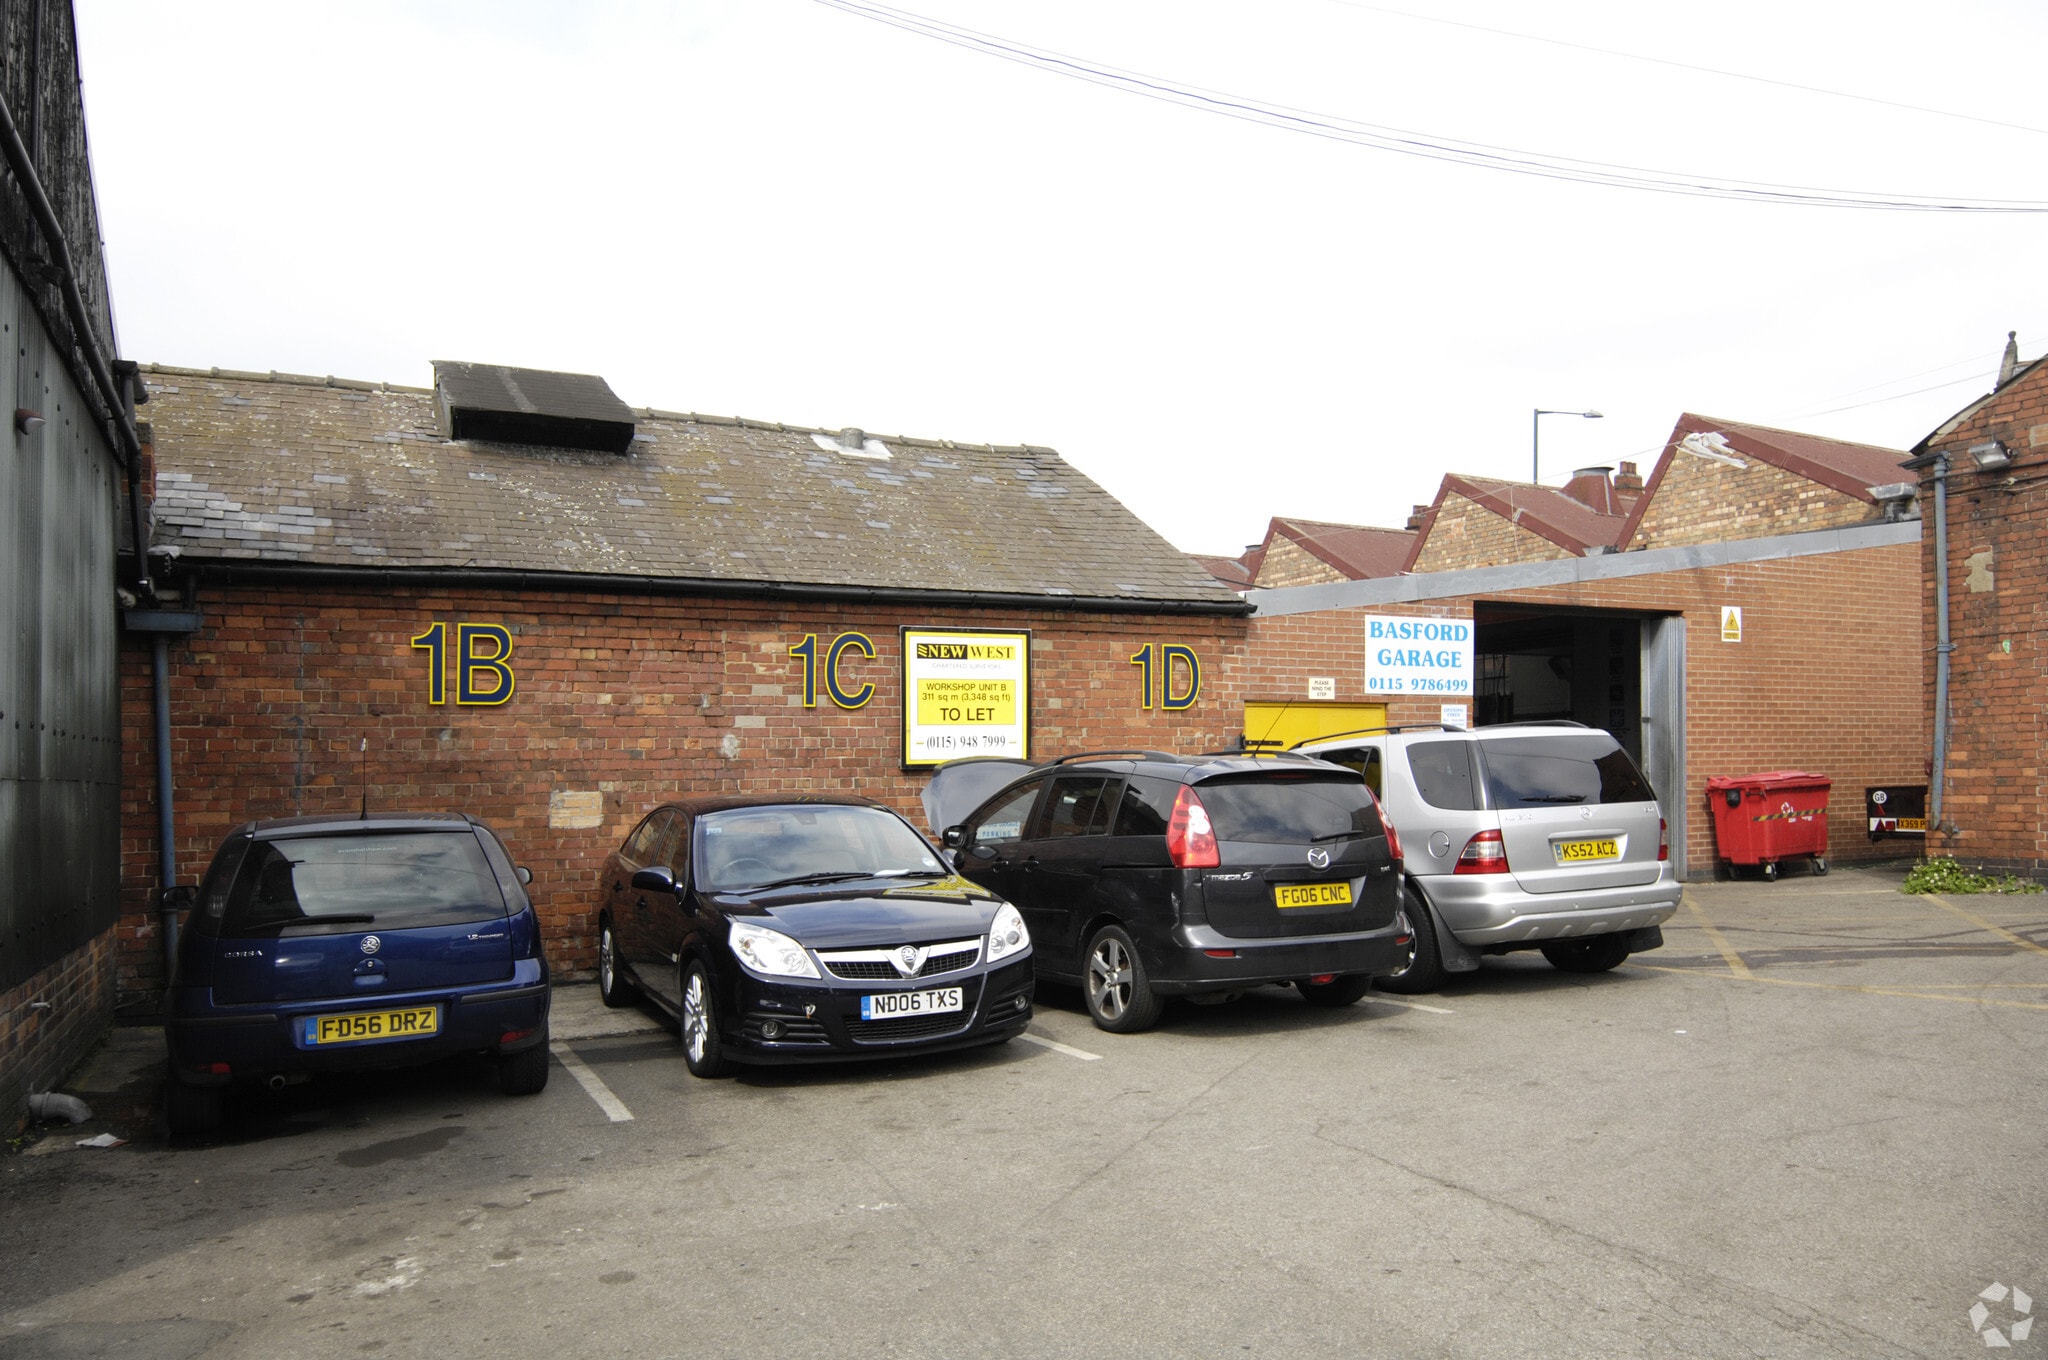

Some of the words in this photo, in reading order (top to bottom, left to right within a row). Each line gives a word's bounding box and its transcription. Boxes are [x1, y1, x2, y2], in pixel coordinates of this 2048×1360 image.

[1369, 621, 1468, 642] BASFORD
[927, 644, 965, 658] NEW
[970, 646, 1013, 659] WEST
[1377, 649, 1462, 668] GARAGE
[411, 622, 515, 705] 1B
[789, 631, 877, 709] 1C
[1130, 642, 1201, 710] 1D
[1369, 677, 1403, 690] 0115
[1411, 678, 1468, 692] 9786499
[926, 683, 976, 691] WORKSHOP
[979, 683, 998, 691] UNIT
[922, 693, 934, 701] 311
[938, 694, 948, 702] sq
[961, 693, 987, 702] (3,348
[989, 694, 999, 702] sq
[1002, 693, 1010, 702] ft)
[940, 708, 961, 721] TO
[967, 708, 995, 721] LET
[926, 735, 956, 750] (0115)
[960, 735, 978, 748] 948
[982, 735, 1006, 748] 7999
[1563, 843, 1593, 858] KS52
[1597, 842, 1617, 856] ACZ
[1282, 888, 1318, 904] FG06
[1321, 886, 1345, 901] CNC
[875, 993, 921, 1014] ND06
[926, 990, 958, 1009] TXS
[322, 1016, 381, 1039] FD56
[389, 1010, 432, 1033] DRZ
